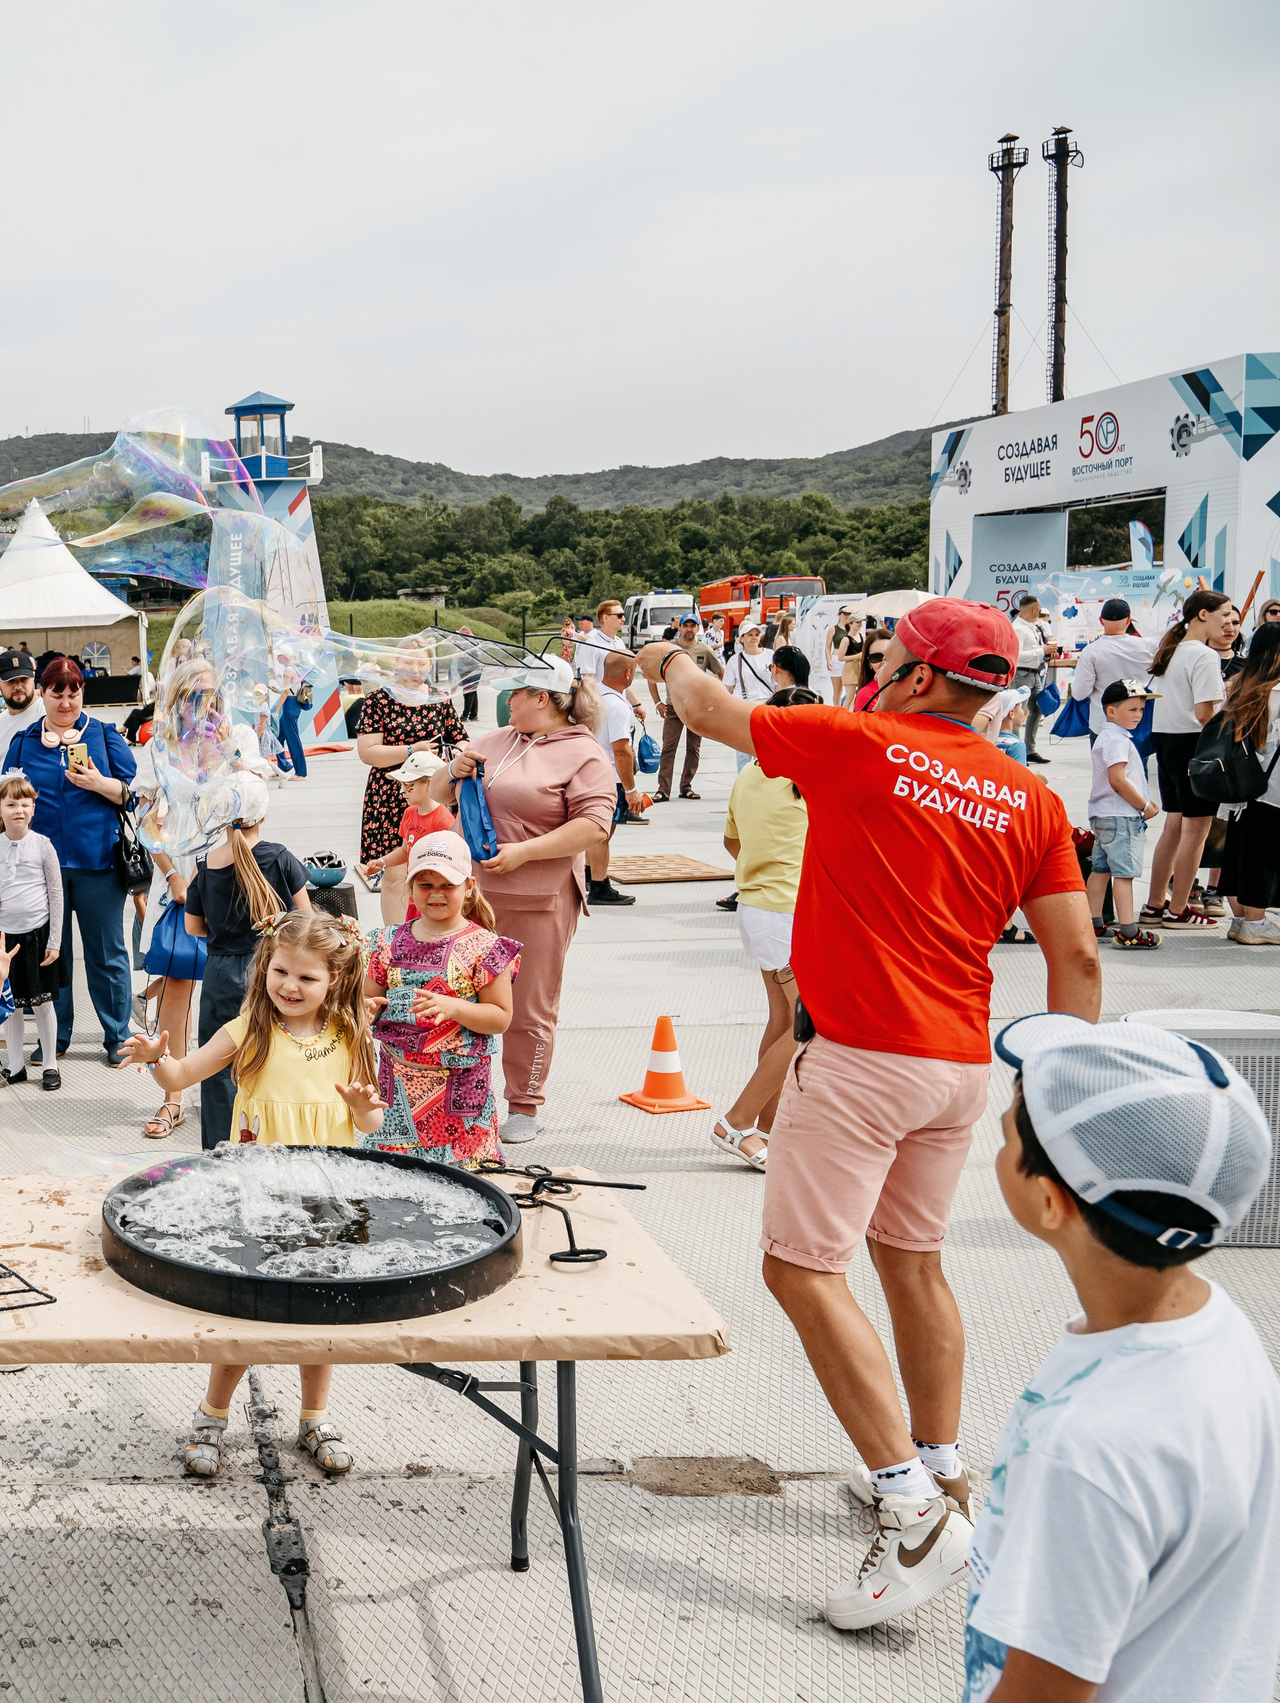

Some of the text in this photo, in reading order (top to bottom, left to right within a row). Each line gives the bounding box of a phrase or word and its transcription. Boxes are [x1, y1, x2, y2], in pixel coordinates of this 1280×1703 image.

[1079, 412, 1119, 458] 50
[997, 434, 1058, 461] СОЗДАВАЯ
[1116, 444, 1126, 453] ЛЕТ
[1004, 460, 1051, 484] БУДУЩЕЕ
[1072, 456, 1133, 476] ВОСТОЧНЫЙ ПОРТ
[989, 562, 1047, 573] СОЗДАВАЯ
[995, 575, 1029, 585] БУДУЩ
[885, 743, 1027, 811] СОЗДАВАЯ
[893, 774, 1011, 834] БУДУЩЕЕ
[427, 851, 453, 861] balance
[526, 1043, 546, 1096] POSITIVE
